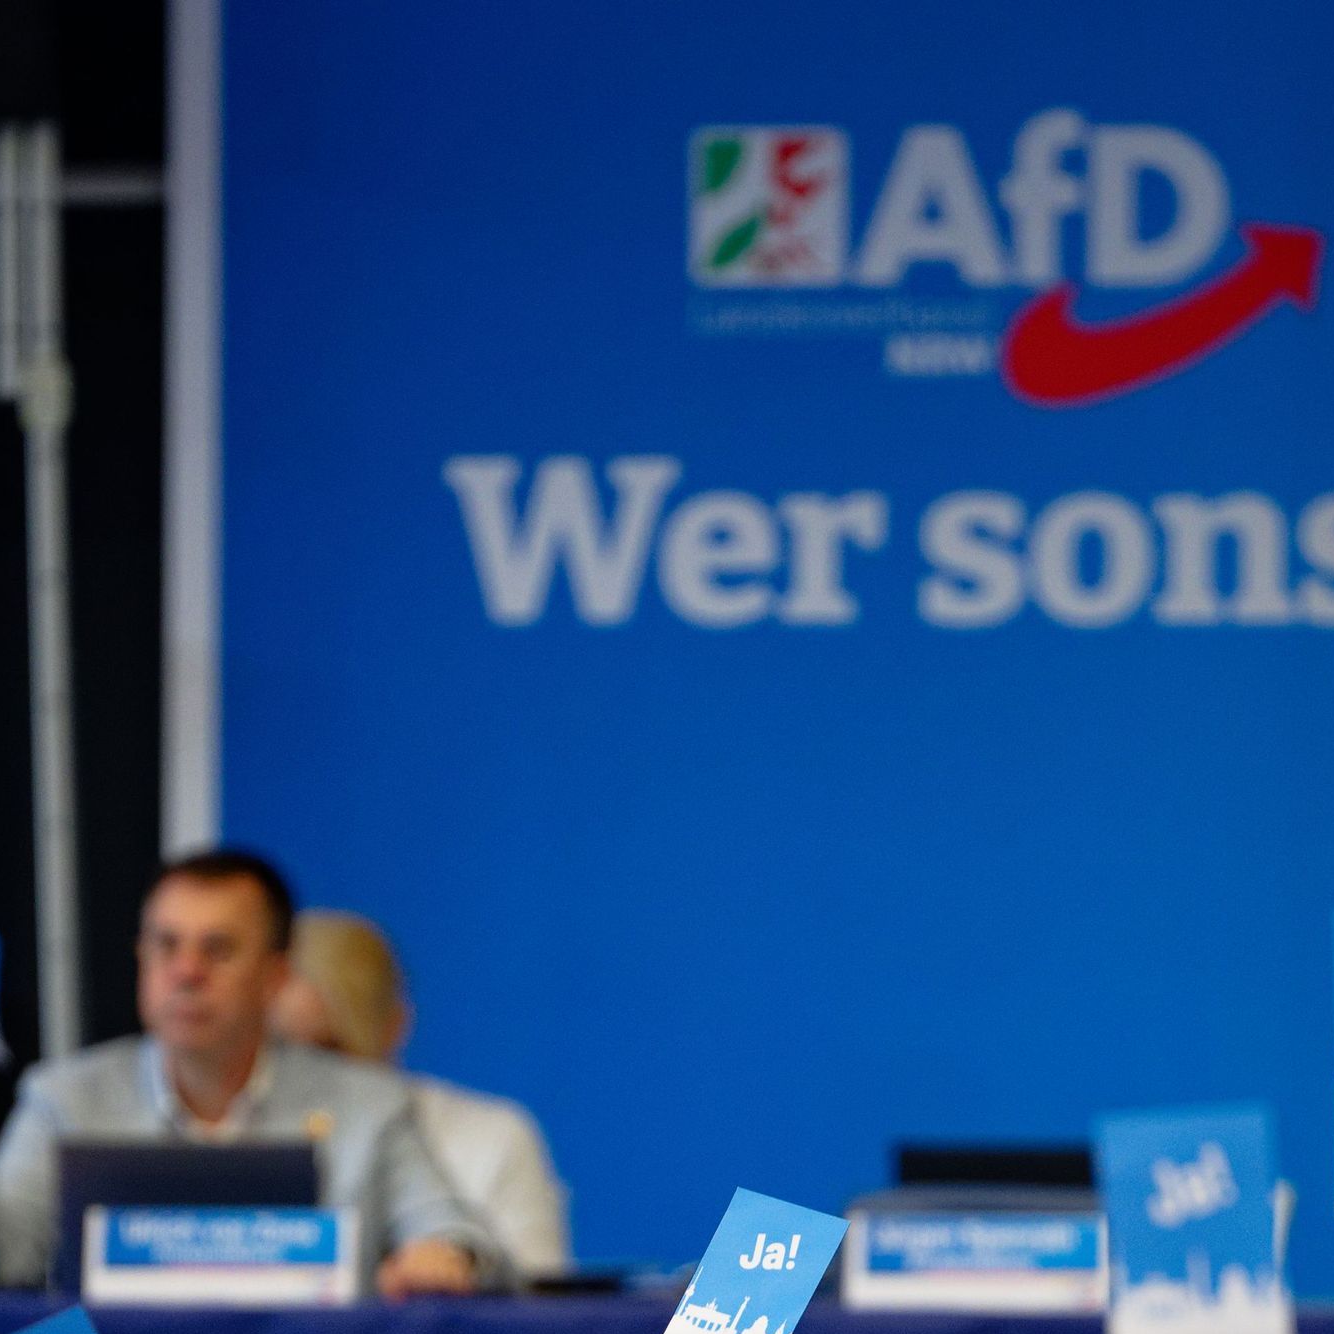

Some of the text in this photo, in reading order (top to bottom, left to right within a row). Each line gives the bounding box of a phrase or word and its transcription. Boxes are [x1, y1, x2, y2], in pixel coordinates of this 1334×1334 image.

[857, 108, 1231, 288] AfD
[443, 454, 889, 628] Wer
[739, 1233, 801, 1270] Ja!
